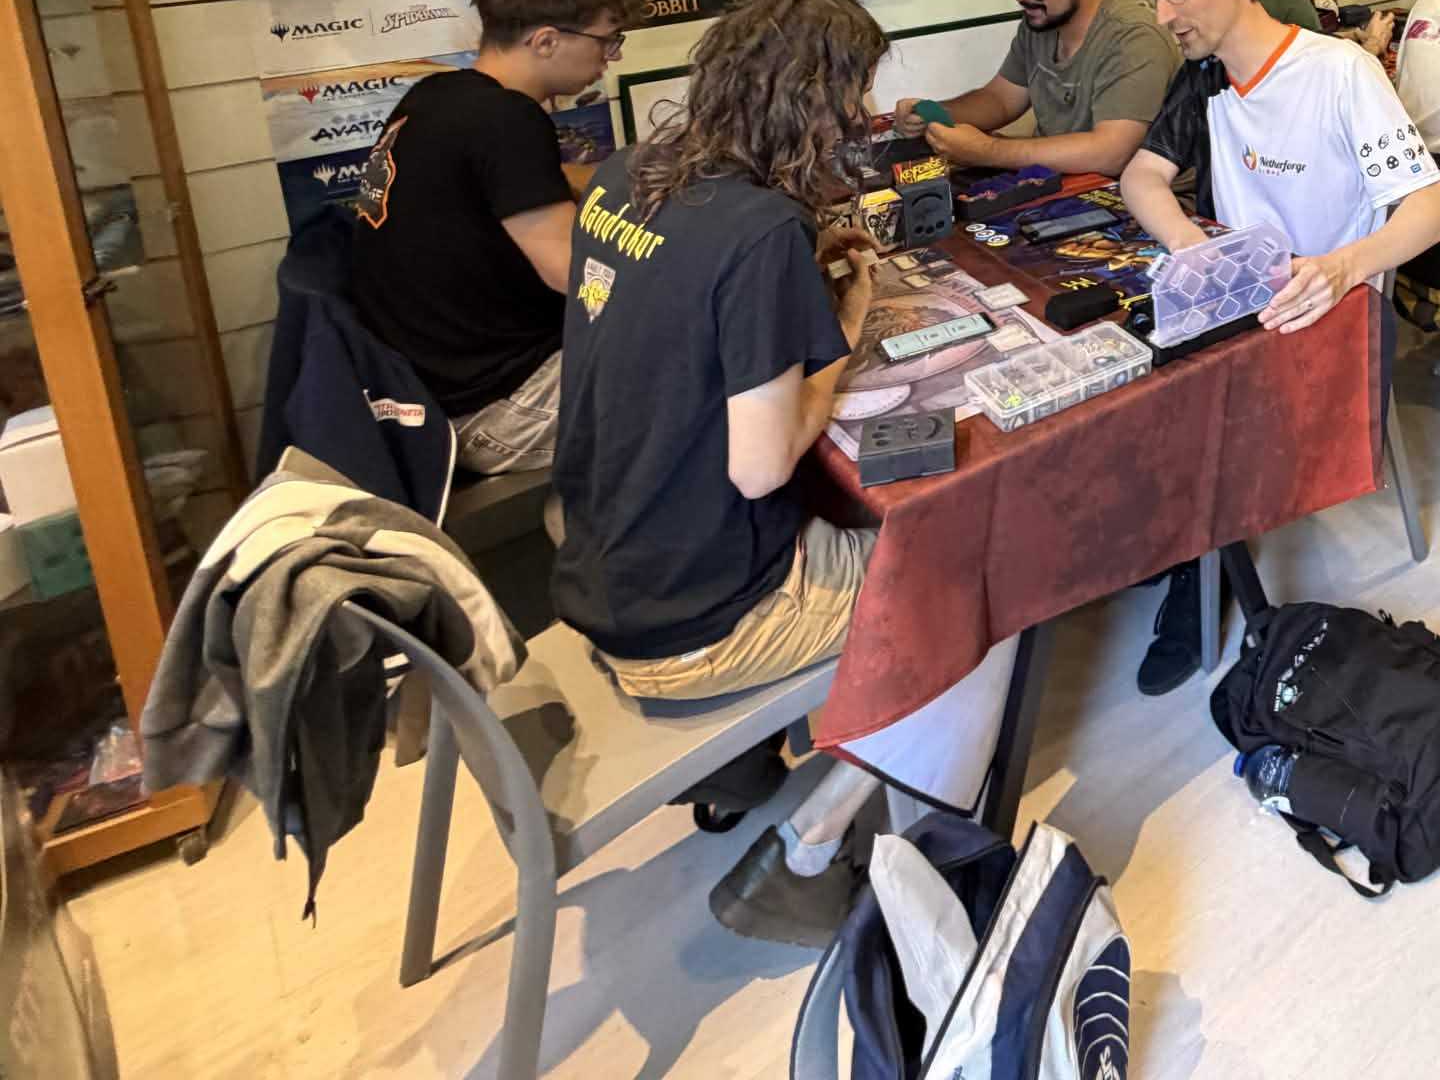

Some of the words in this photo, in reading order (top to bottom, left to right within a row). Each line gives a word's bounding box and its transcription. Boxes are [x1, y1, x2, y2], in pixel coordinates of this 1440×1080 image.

[292, 18, 365, 36] MAGIC
[322, 74, 404, 98] MAGIC
[1259, 156, 1308, 174] Netherforge
